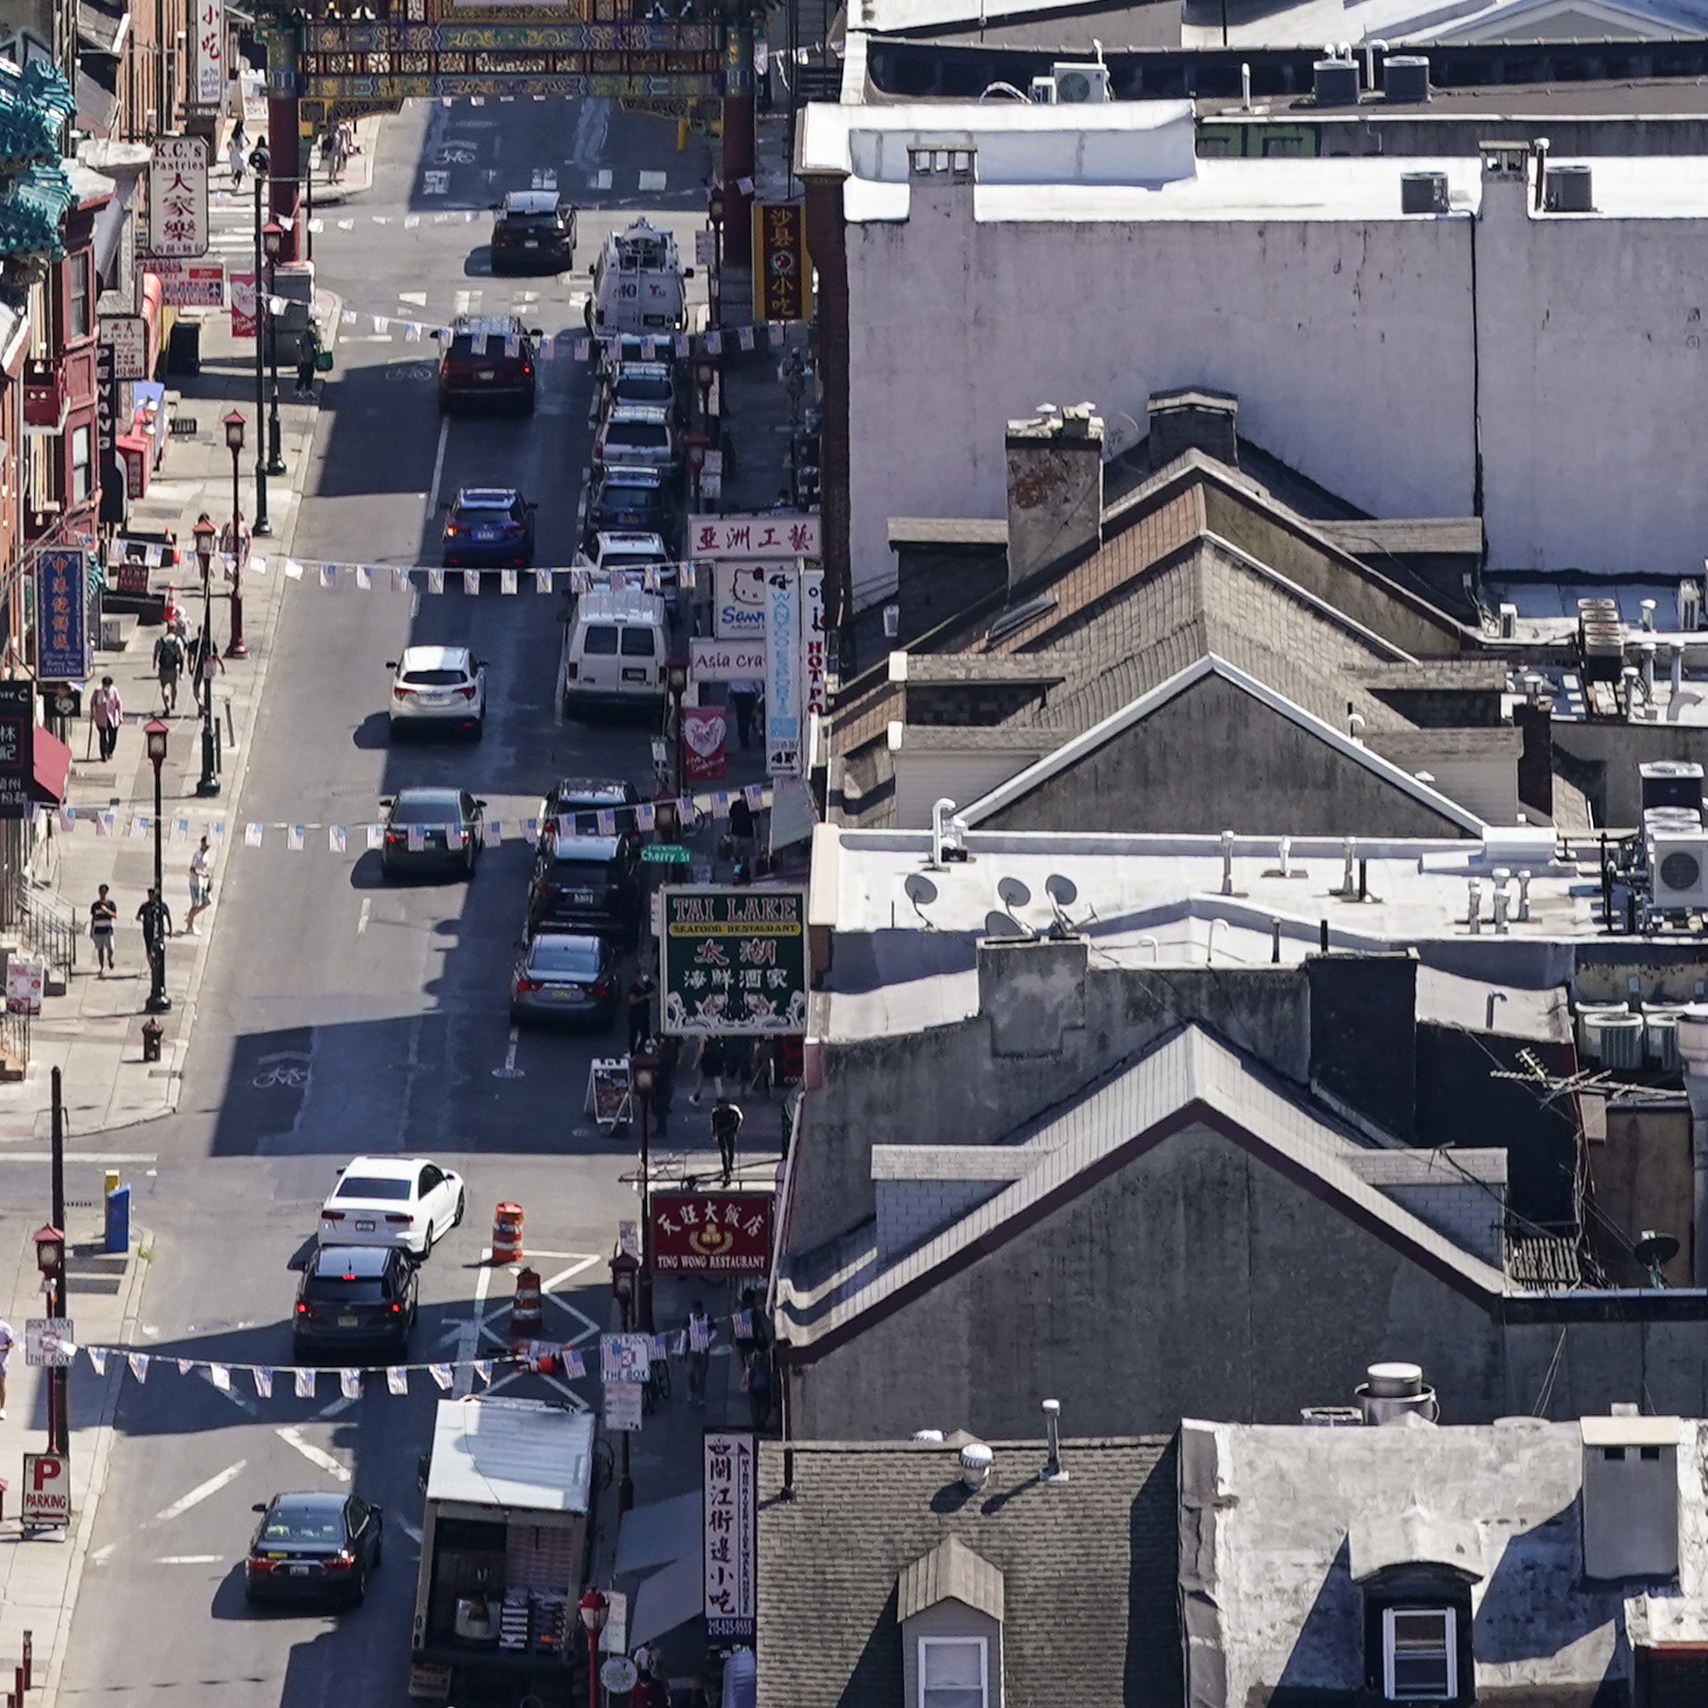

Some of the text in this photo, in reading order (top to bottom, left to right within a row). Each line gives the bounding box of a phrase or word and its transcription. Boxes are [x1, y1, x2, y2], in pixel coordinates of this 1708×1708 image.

[152, 160, 205, 171] Pastries
[161, 173, 196, 242] 大家樂
[695, 651, 731, 669] Asia
[807, 641, 823, 683] HOT
[17, 688, 29, 703] C
[642, 851, 690, 864] Cherry St
[673, 897, 797, 922] TAI LAKE
[673, 923, 798, 934] SEAFOOD RESTAURANT
[694, 937, 777, 966] 太湖
[683, 968, 788, 990] 海鮮酒家
[657, 1254, 766, 1269] TING WONG RESTAURANT
[33, 1458, 61, 1491] P
[25, 1494, 67, 1509] PARKING
